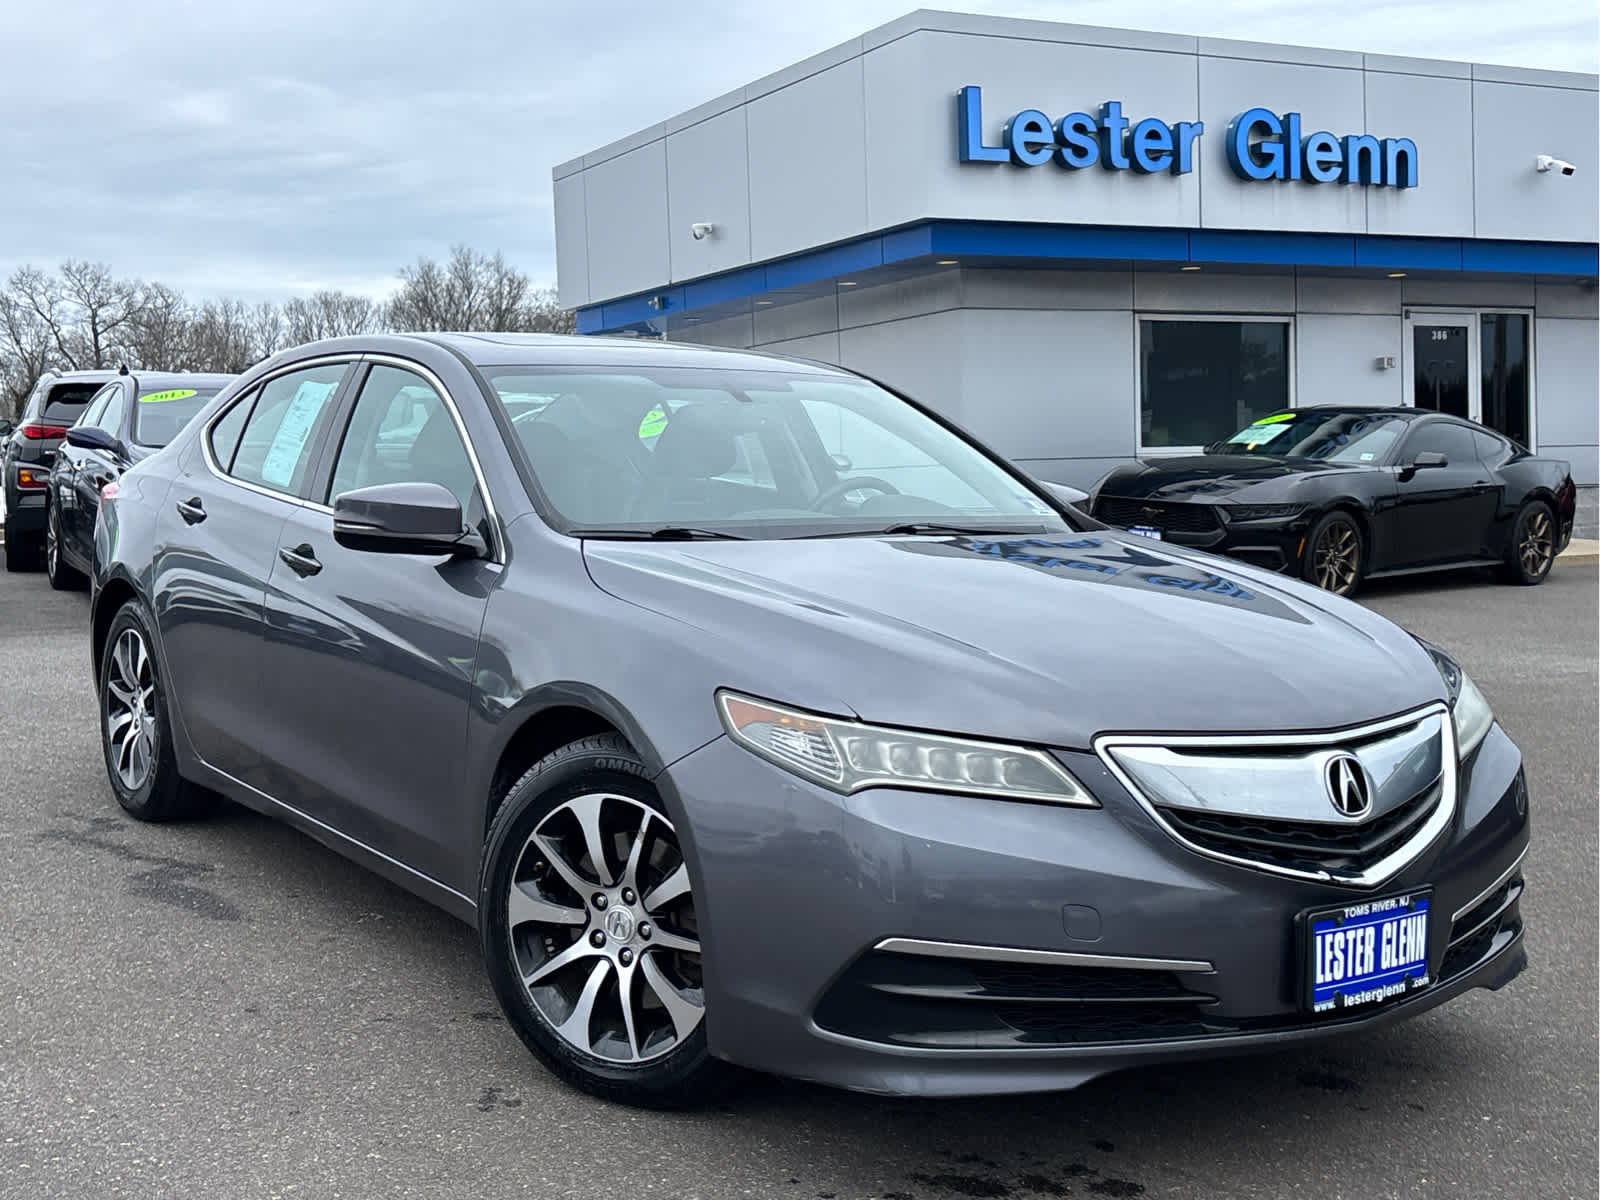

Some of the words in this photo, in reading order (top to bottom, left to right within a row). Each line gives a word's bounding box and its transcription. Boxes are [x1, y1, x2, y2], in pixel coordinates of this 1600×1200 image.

[958, 86, 1203, 174] Lester
[1227, 107, 1419, 189] Glenn
[1345, 904, 1370, 919] TOMS
[1399, 897, 1410, 907] NJ
[1315, 927, 1376, 984] LESTER
[1381, 915, 1427, 970] GLENN
[1345, 983, 1406, 1007] lesterglenn
